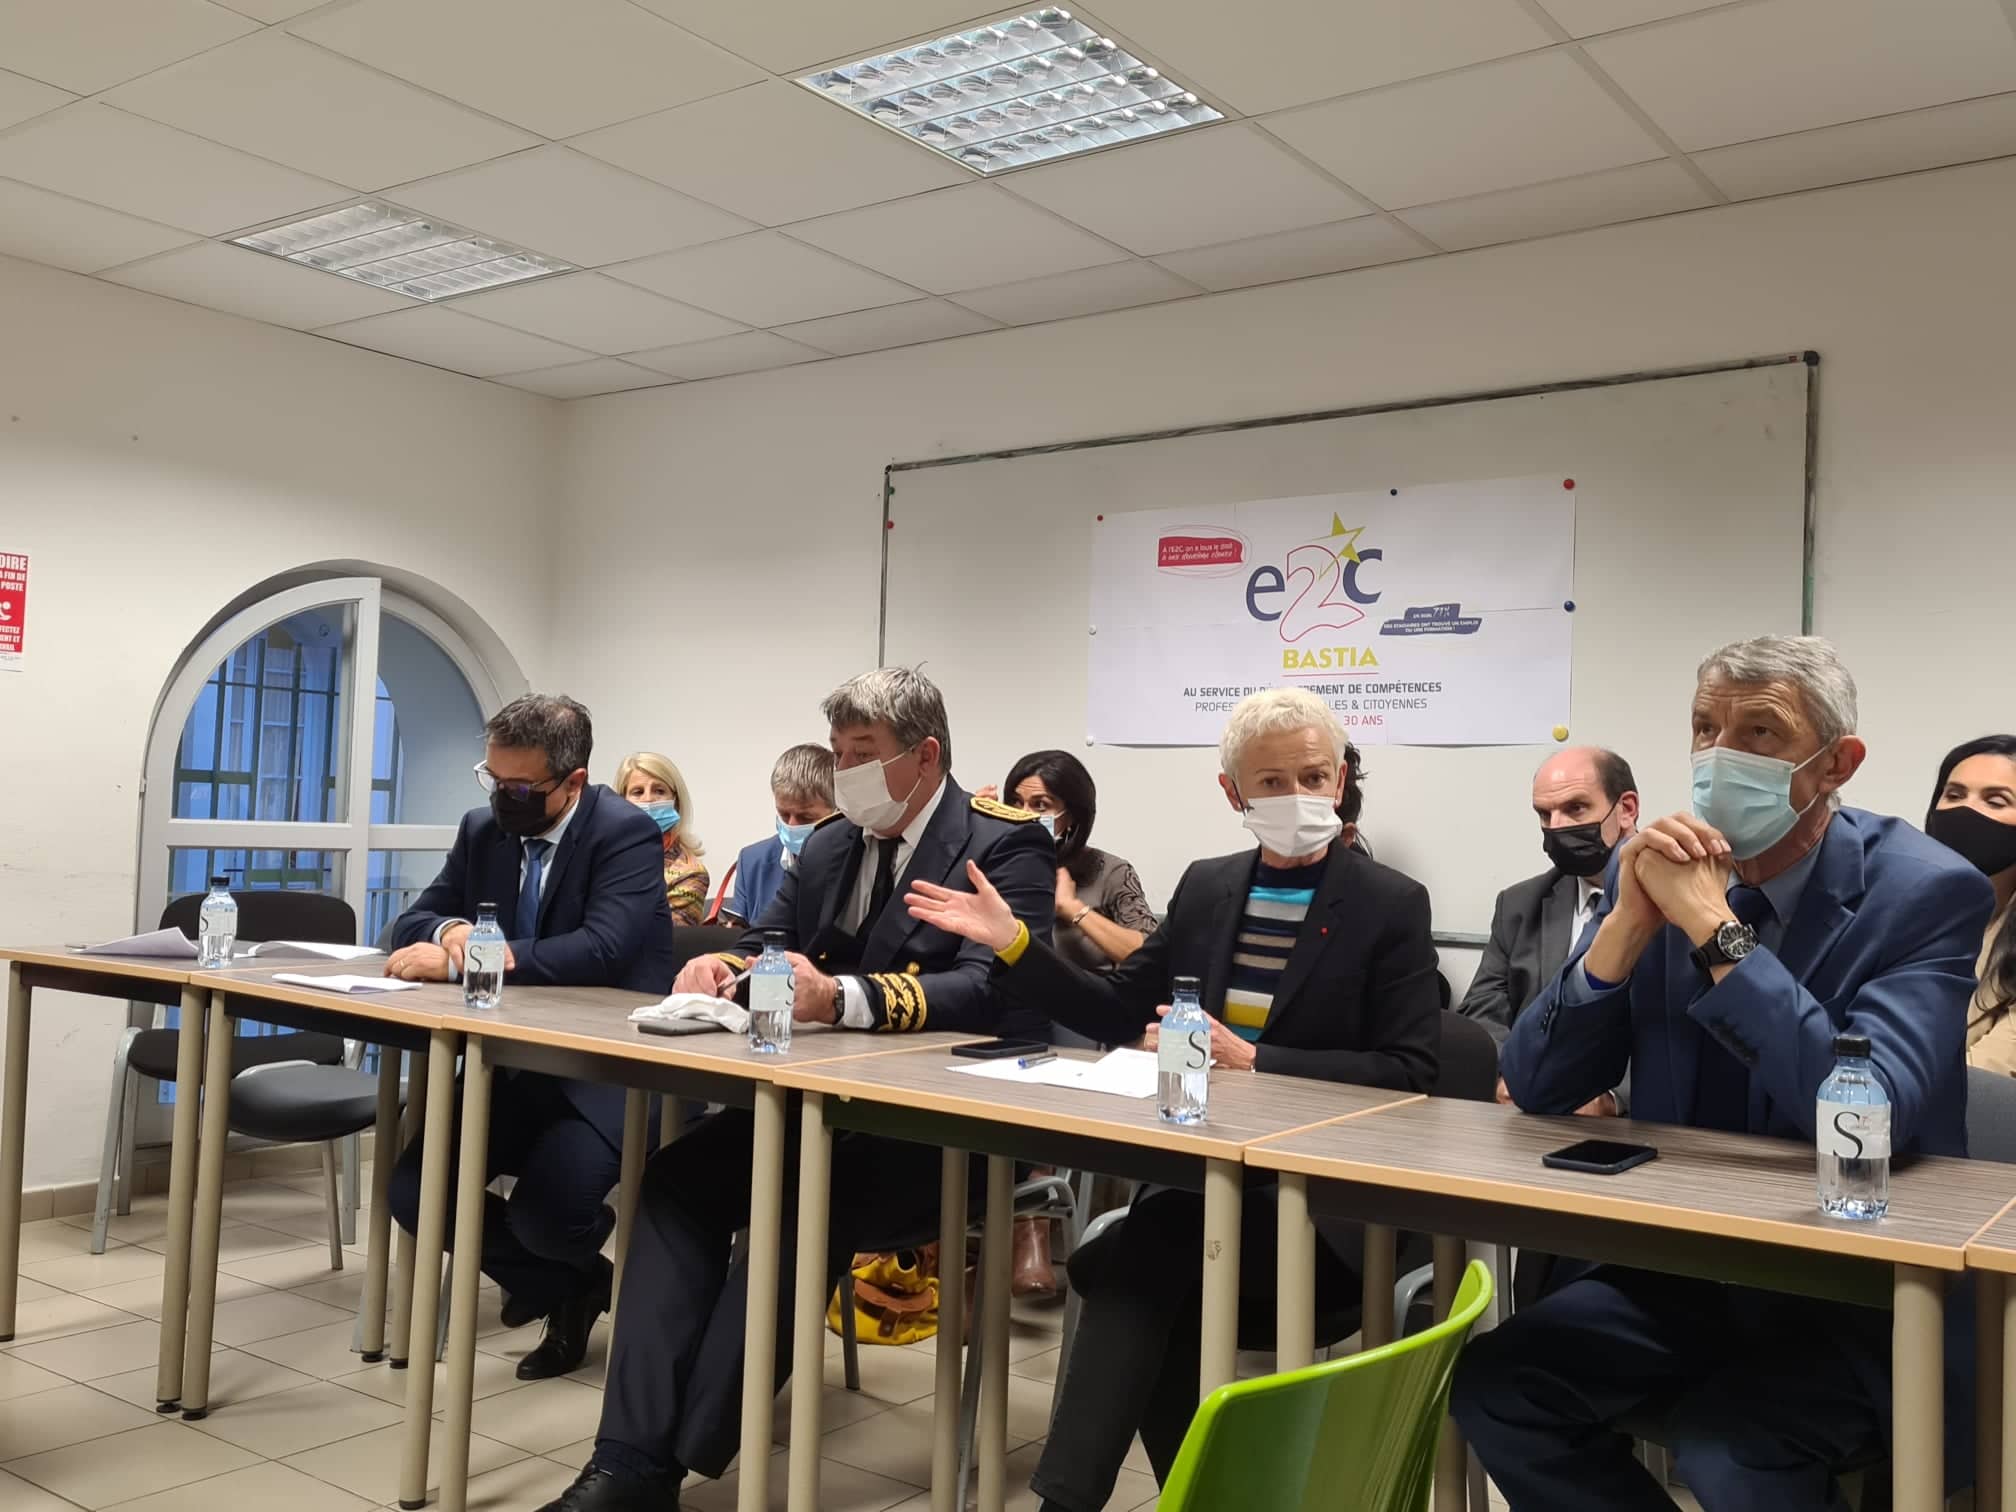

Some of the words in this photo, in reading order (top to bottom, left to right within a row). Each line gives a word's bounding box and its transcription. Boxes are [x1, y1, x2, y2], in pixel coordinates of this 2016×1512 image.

[1283, 646, 1379, 669] BASTIA
[1183, 687, 1197, 697] AU
[1200, 687, 1241, 697] SERVICE
[1348, 683, 1363, 694] DE
[1365, 680, 1442, 694] COMPÉTENCES
[1351, 699, 1359, 710] &
[1363, 698, 1428, 710] CITOYENNES
[1343, 715, 1358, 726] 30
[1361, 714, 1384, 726] ANS
[1186, 1030, 1207, 1070] S
[1832, 1111, 1864, 1159] S
